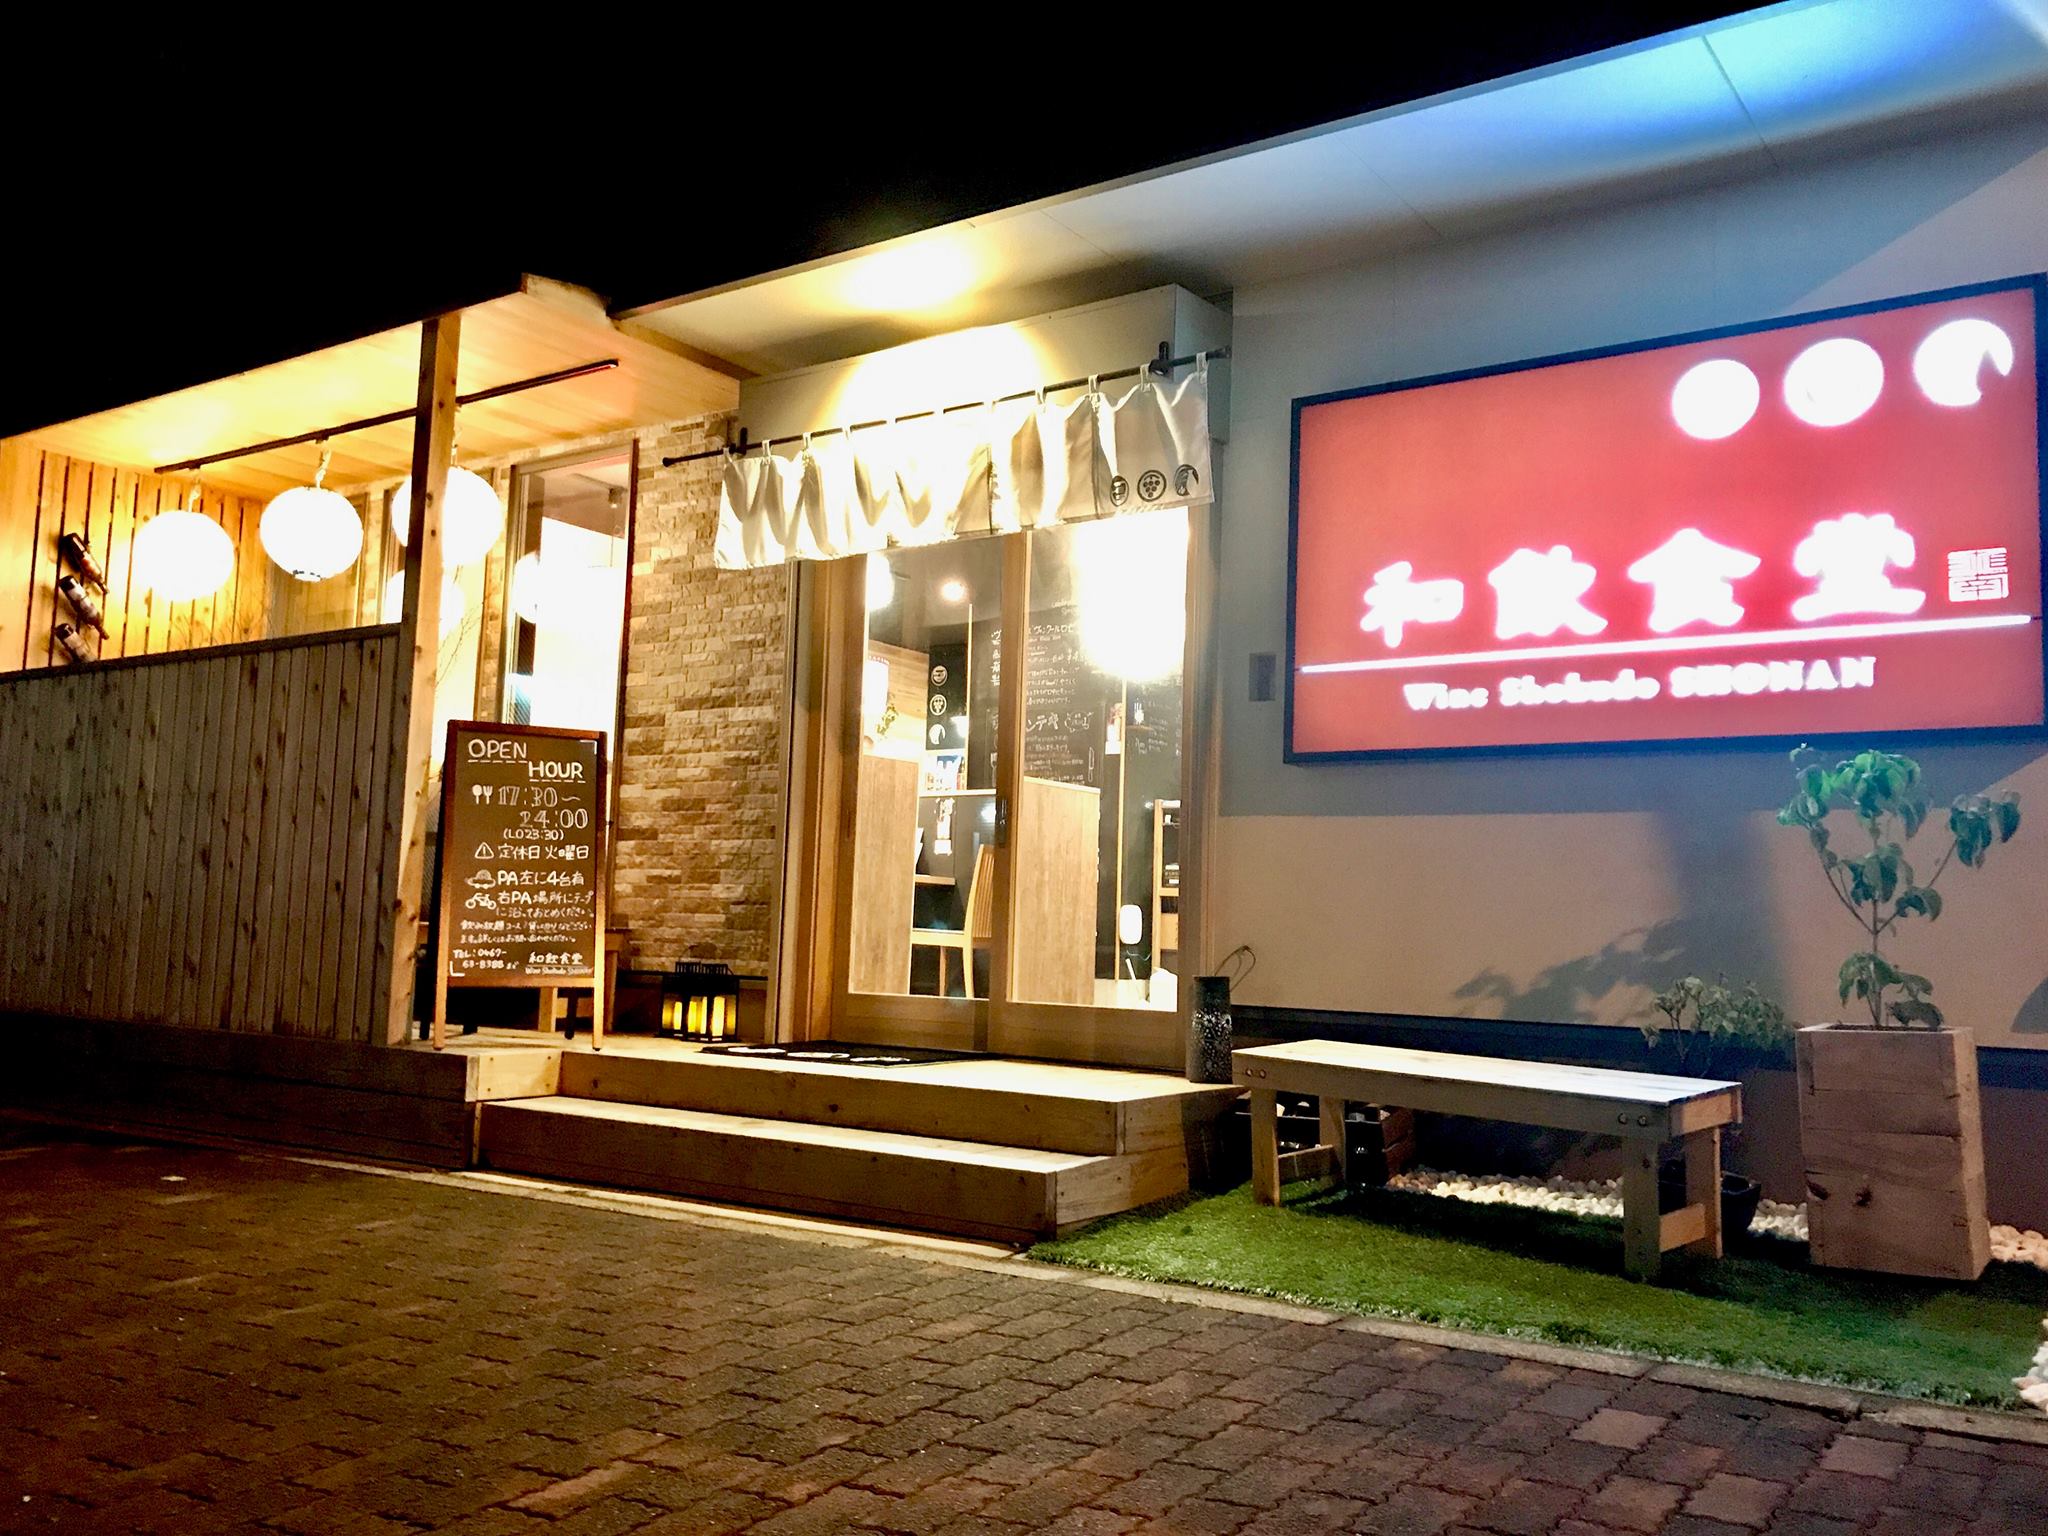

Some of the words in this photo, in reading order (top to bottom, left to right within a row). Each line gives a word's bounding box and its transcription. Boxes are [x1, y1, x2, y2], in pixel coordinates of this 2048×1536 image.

[1360, 513, 1926, 648] 和飲食堂
[1403, 682, 1489, 711] Wine
[1500, 668, 1661, 707] Shokudo
[1669, 656, 1877, 699] SHONAN
[468, 739, 527, 759] OPEN
[528, 760, 584, 779] HOUR
[519, 808, 589, 830] 24:00
